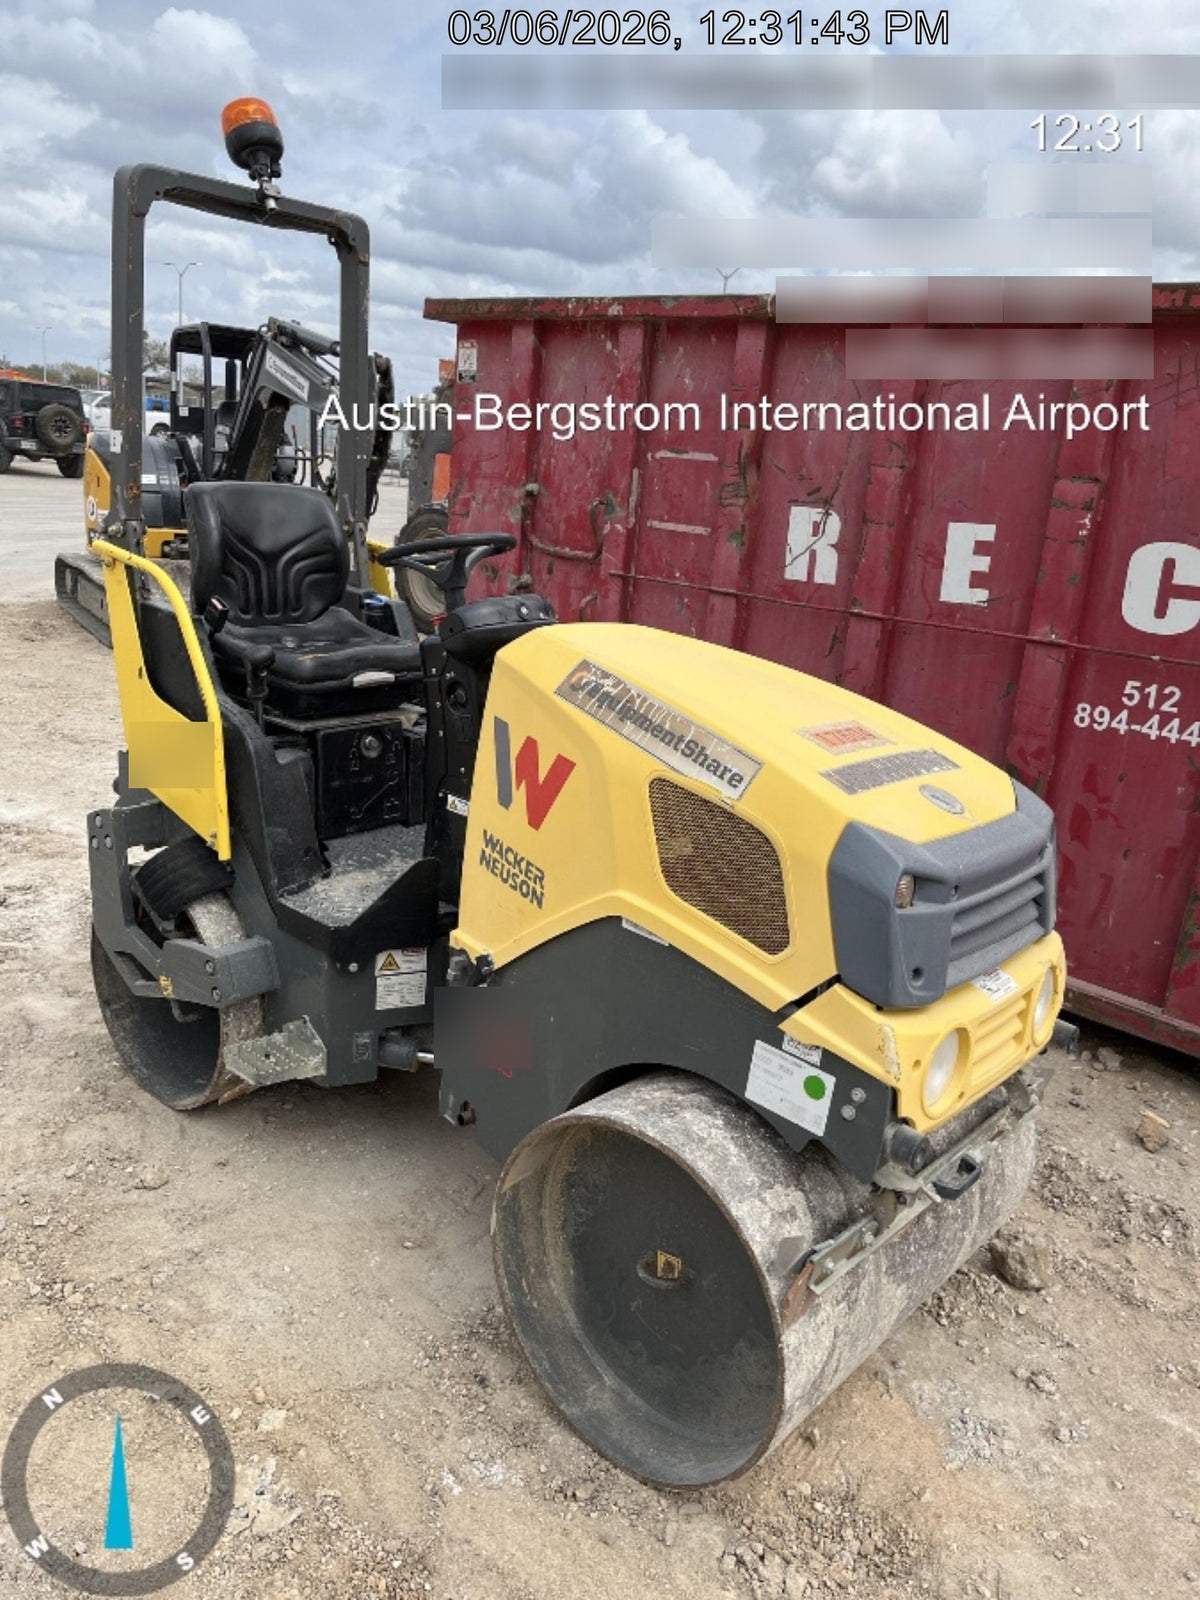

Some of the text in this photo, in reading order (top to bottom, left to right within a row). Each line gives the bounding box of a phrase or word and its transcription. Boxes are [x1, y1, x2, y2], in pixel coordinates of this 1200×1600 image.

[1121, 680, 1182, 714] 512
[1073, 702, 1200, 748] 894-444
[480, 849, 545, 910] NEUSON
[483, 828, 546, 890] WACKER
